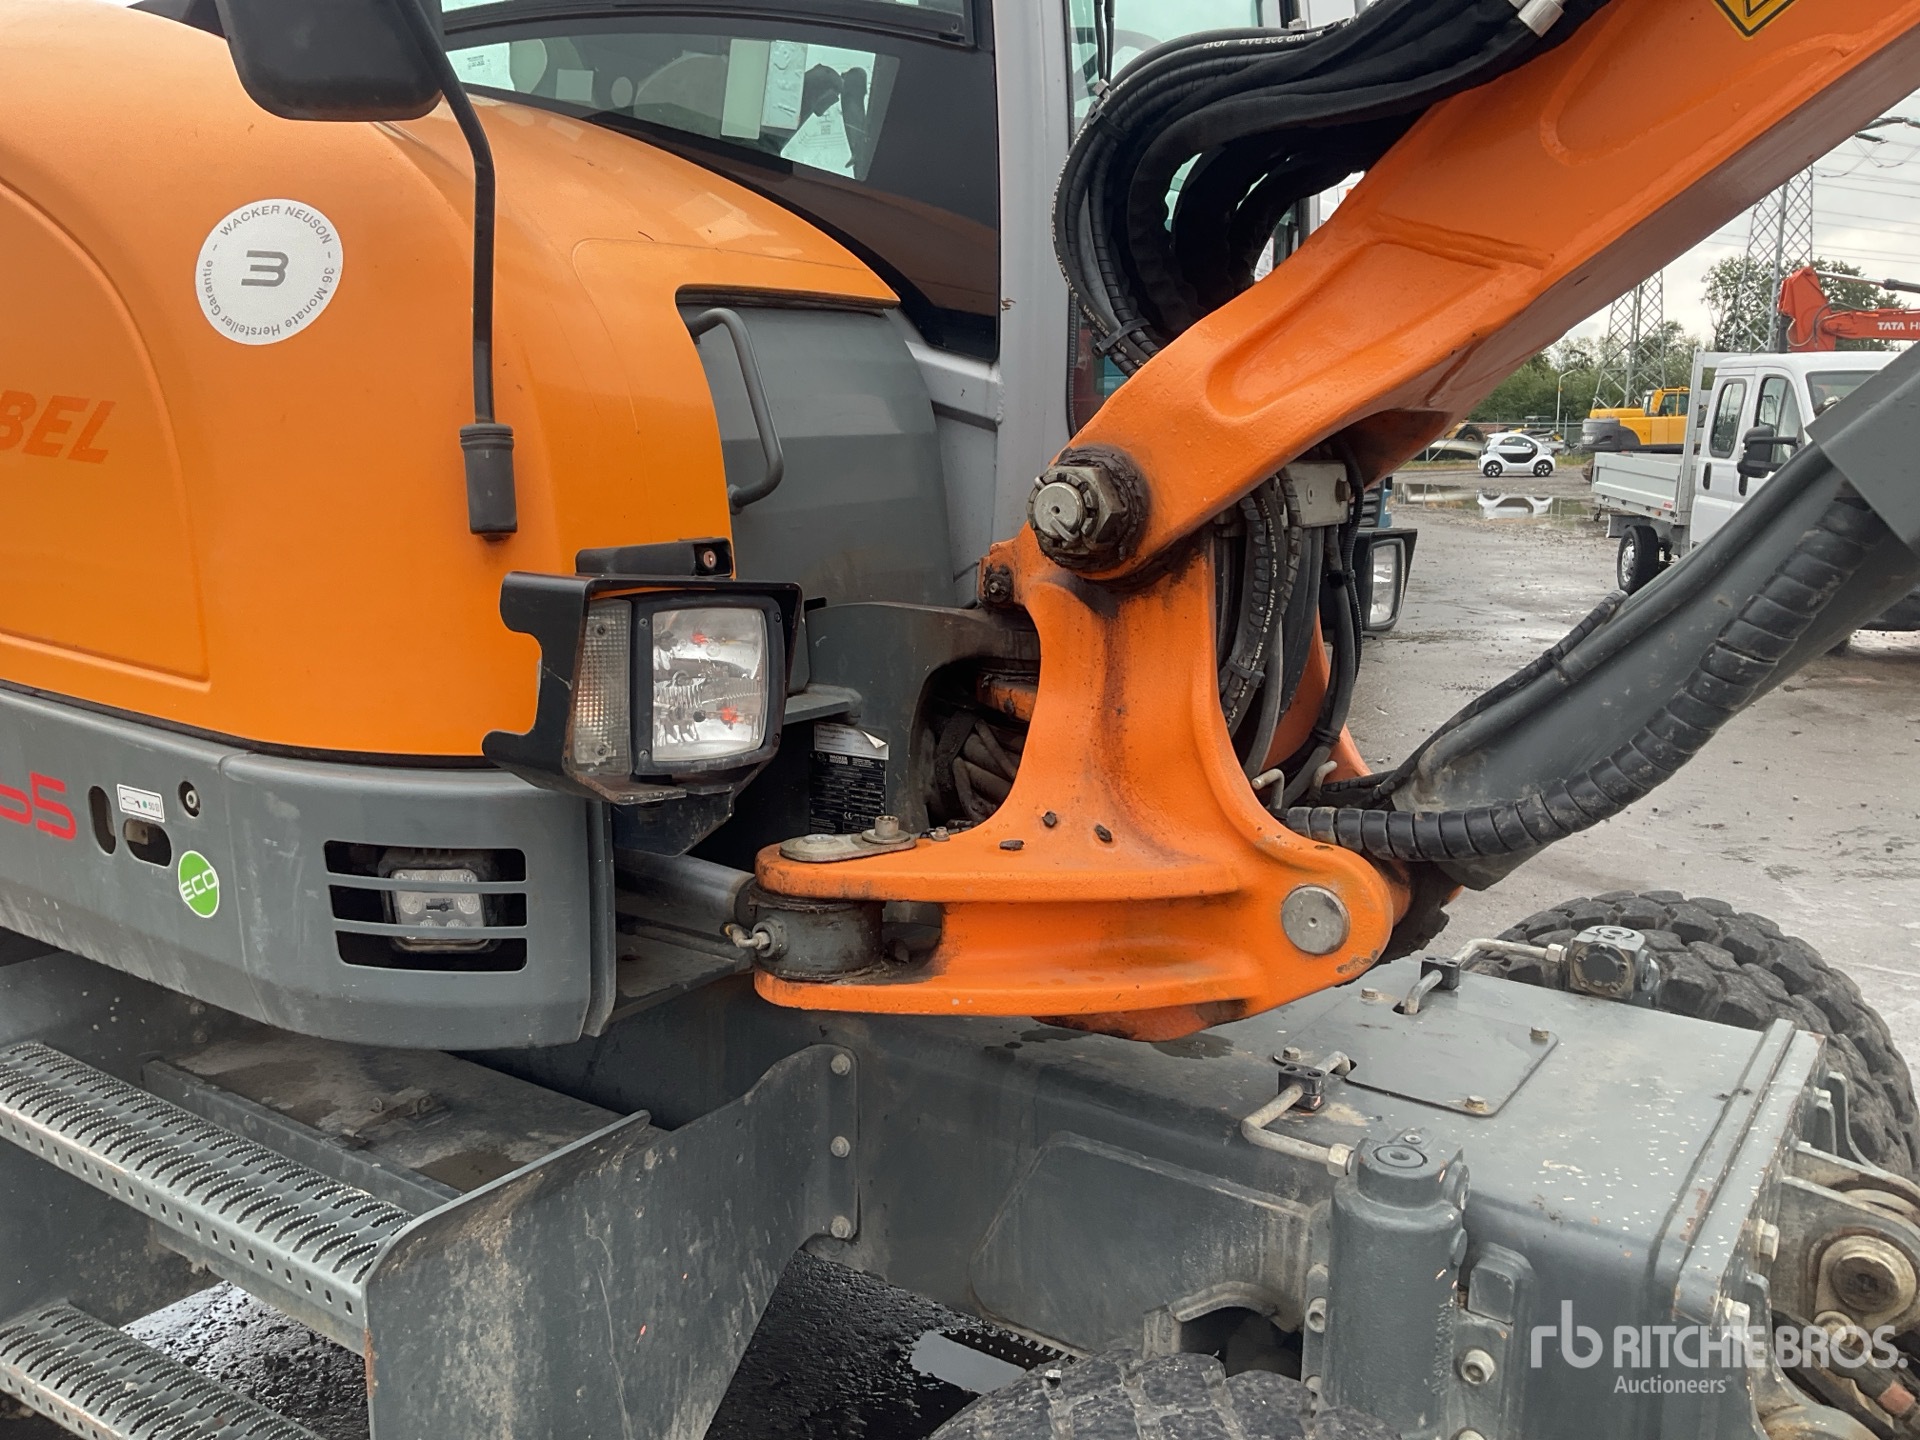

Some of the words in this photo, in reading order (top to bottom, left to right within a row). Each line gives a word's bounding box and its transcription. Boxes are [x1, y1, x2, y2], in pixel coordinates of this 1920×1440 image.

[220, 205, 280, 236] WACKER
[285, 206, 332, 245] NEUSON
[203, 260, 221, 316] Garantie
[322, 268, 335, 284] 36
[285, 287, 328, 328] Monate
[220, 315, 281, 336] Hersteller
[1877, 321, 1906, 331] TATA
[1910, 321, 1920, 331] H
[0, 390, 116, 465] BEL
[180, 867, 219, 902] ECO
